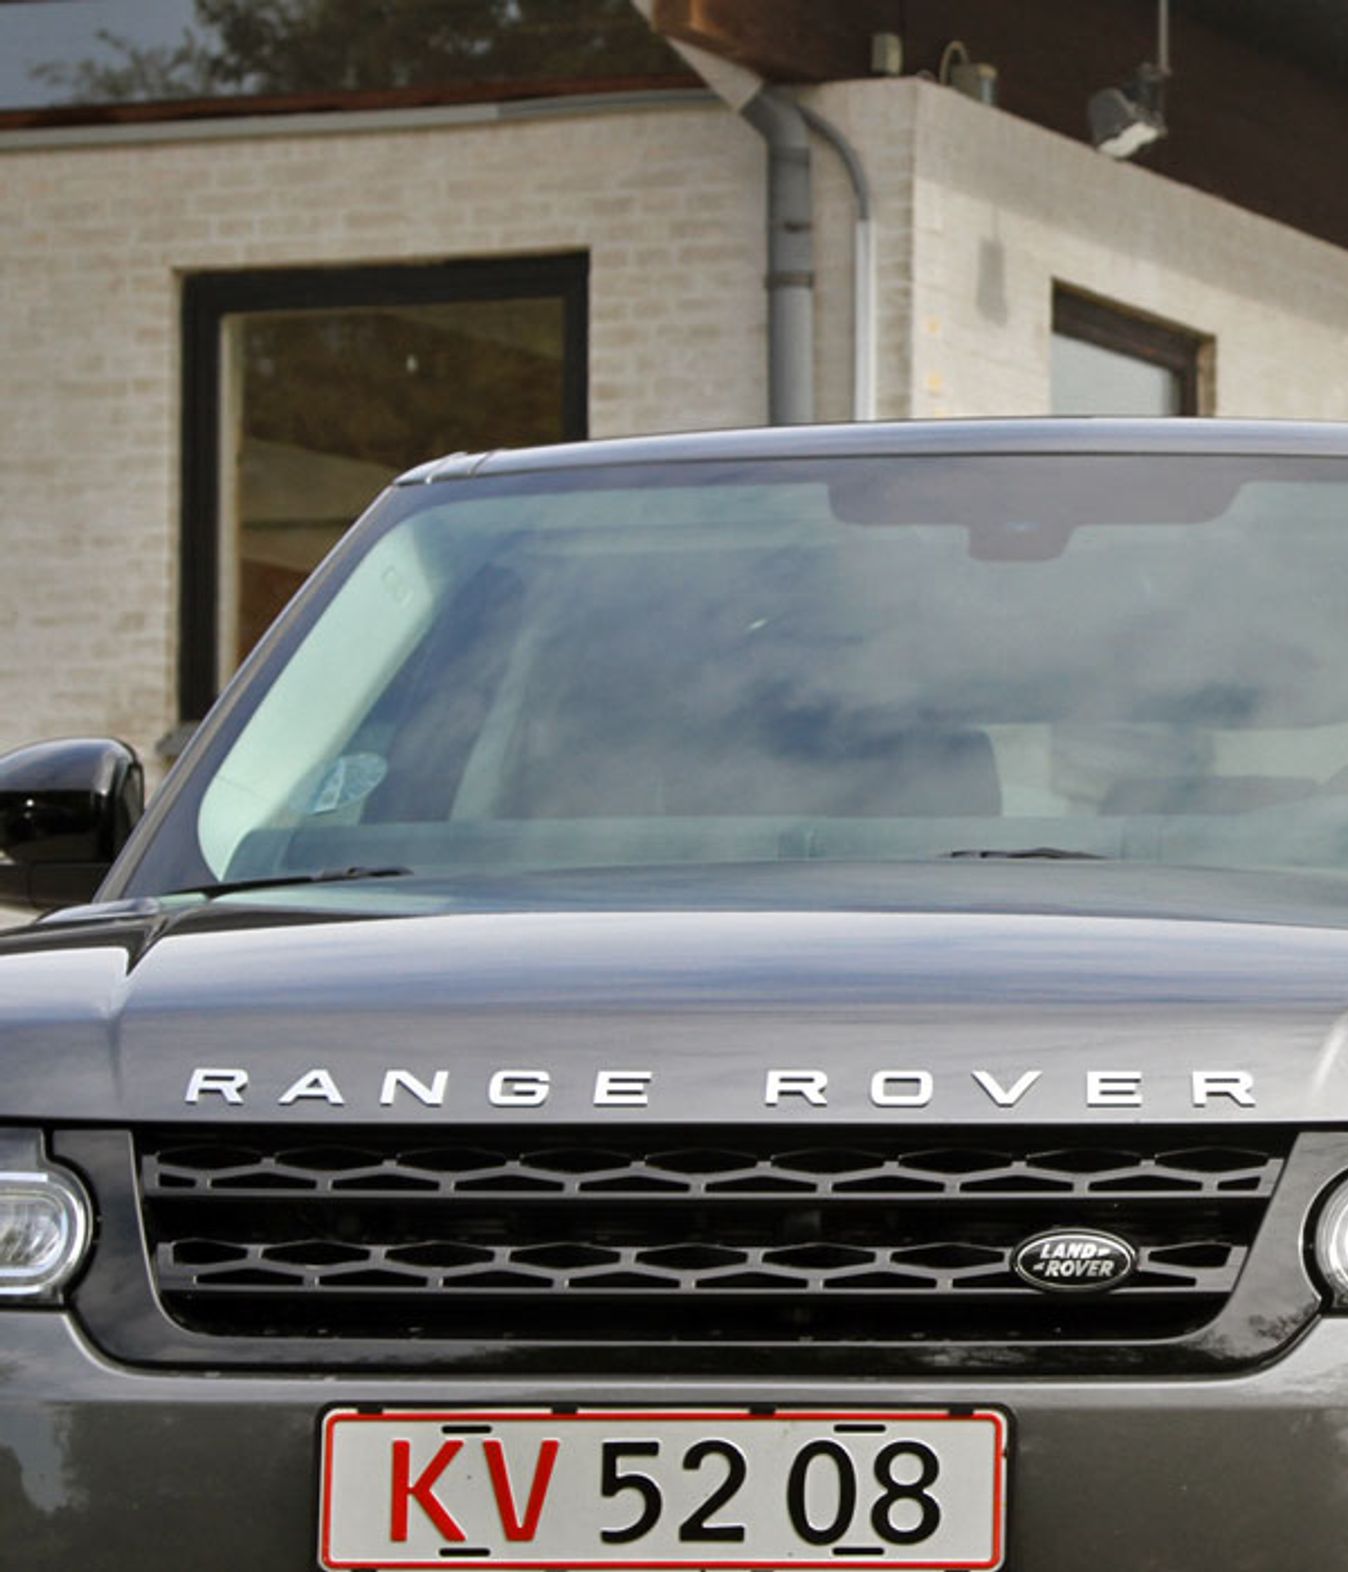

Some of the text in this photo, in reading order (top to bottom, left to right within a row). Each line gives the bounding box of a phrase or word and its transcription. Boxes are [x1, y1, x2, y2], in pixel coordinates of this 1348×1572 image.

[184, 1068, 1255, 1108] RANGE ROVER
[1040, 1243, 1097, 1259] LAND
[1044, 1260, 1115, 1277] ROVER
[390, 1439, 942, 1546] KV 52 08
